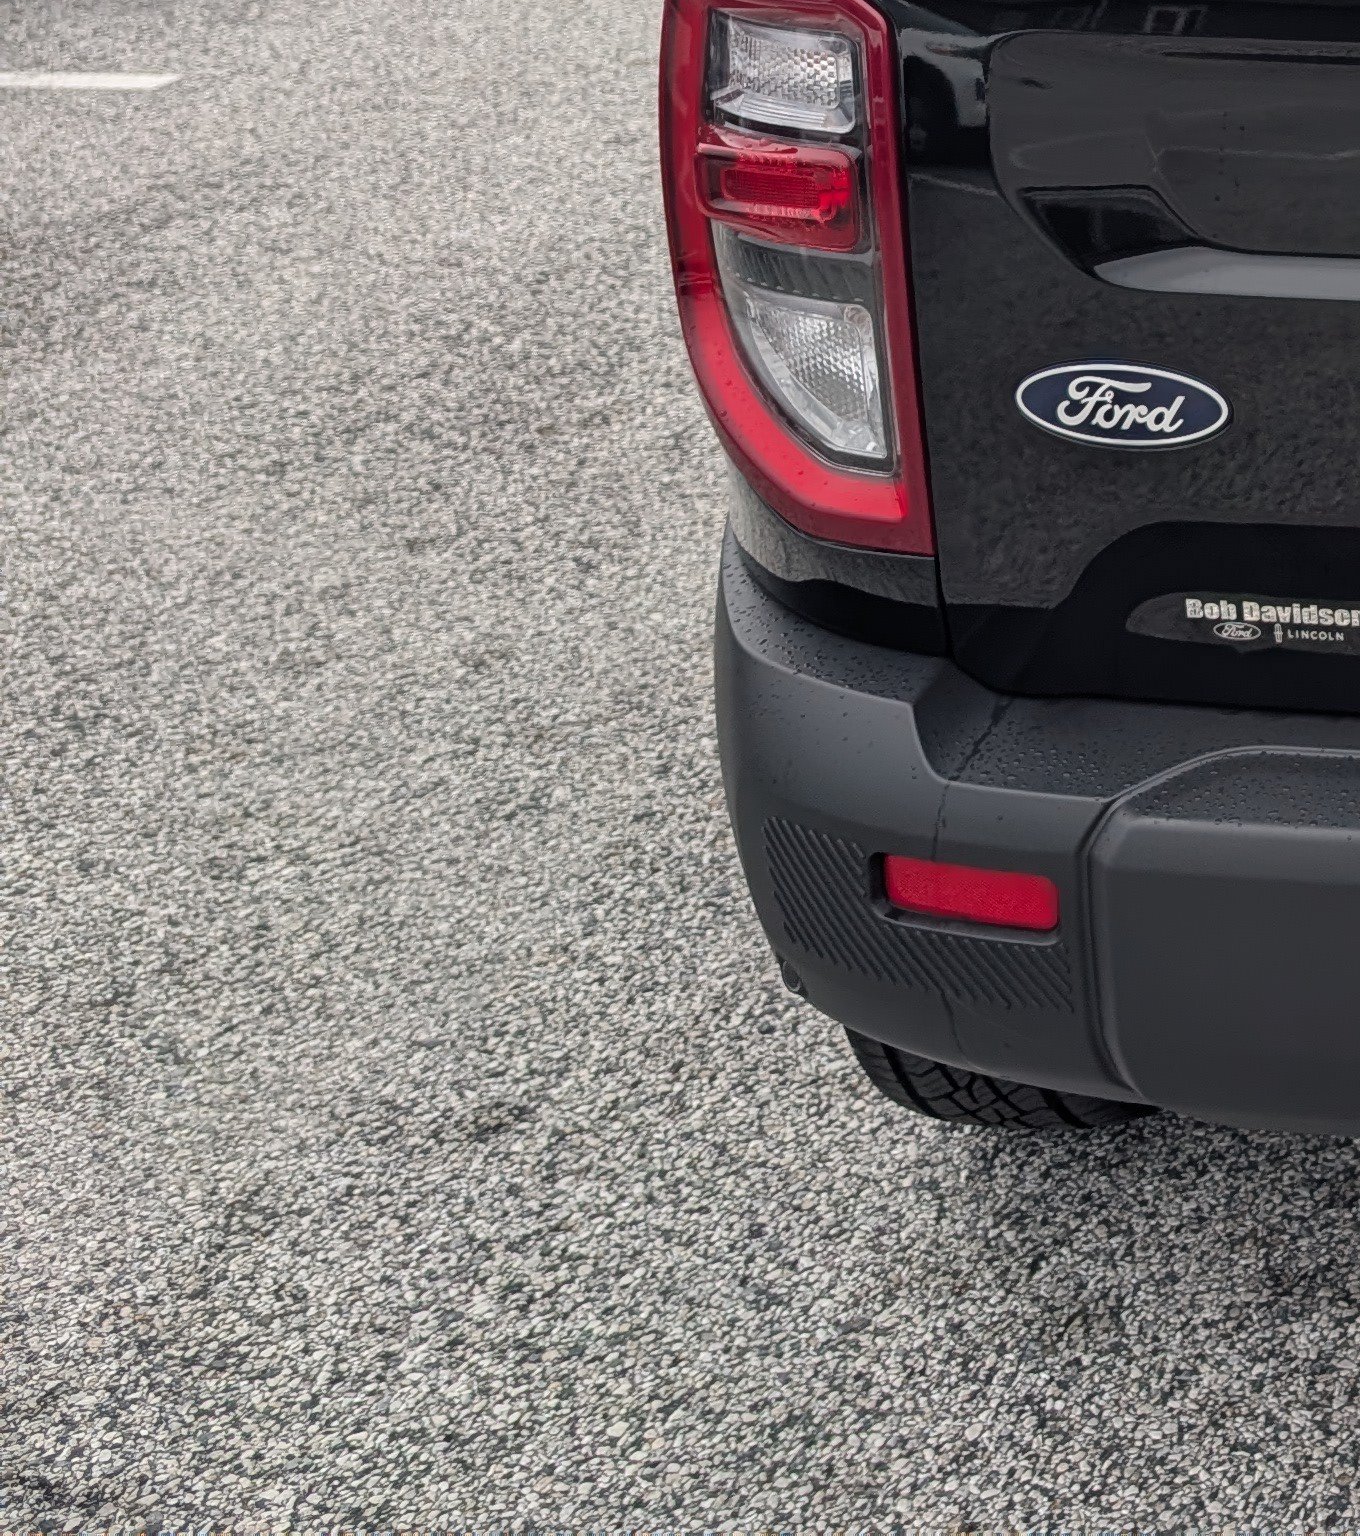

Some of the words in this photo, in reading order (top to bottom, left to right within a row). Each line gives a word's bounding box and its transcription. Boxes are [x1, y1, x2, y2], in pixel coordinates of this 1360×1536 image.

[1057, 375, 1186, 433] Ford
[1186, 598, 1237, 620] Bob
[1287, 629, 1345, 642] LINCOLN
